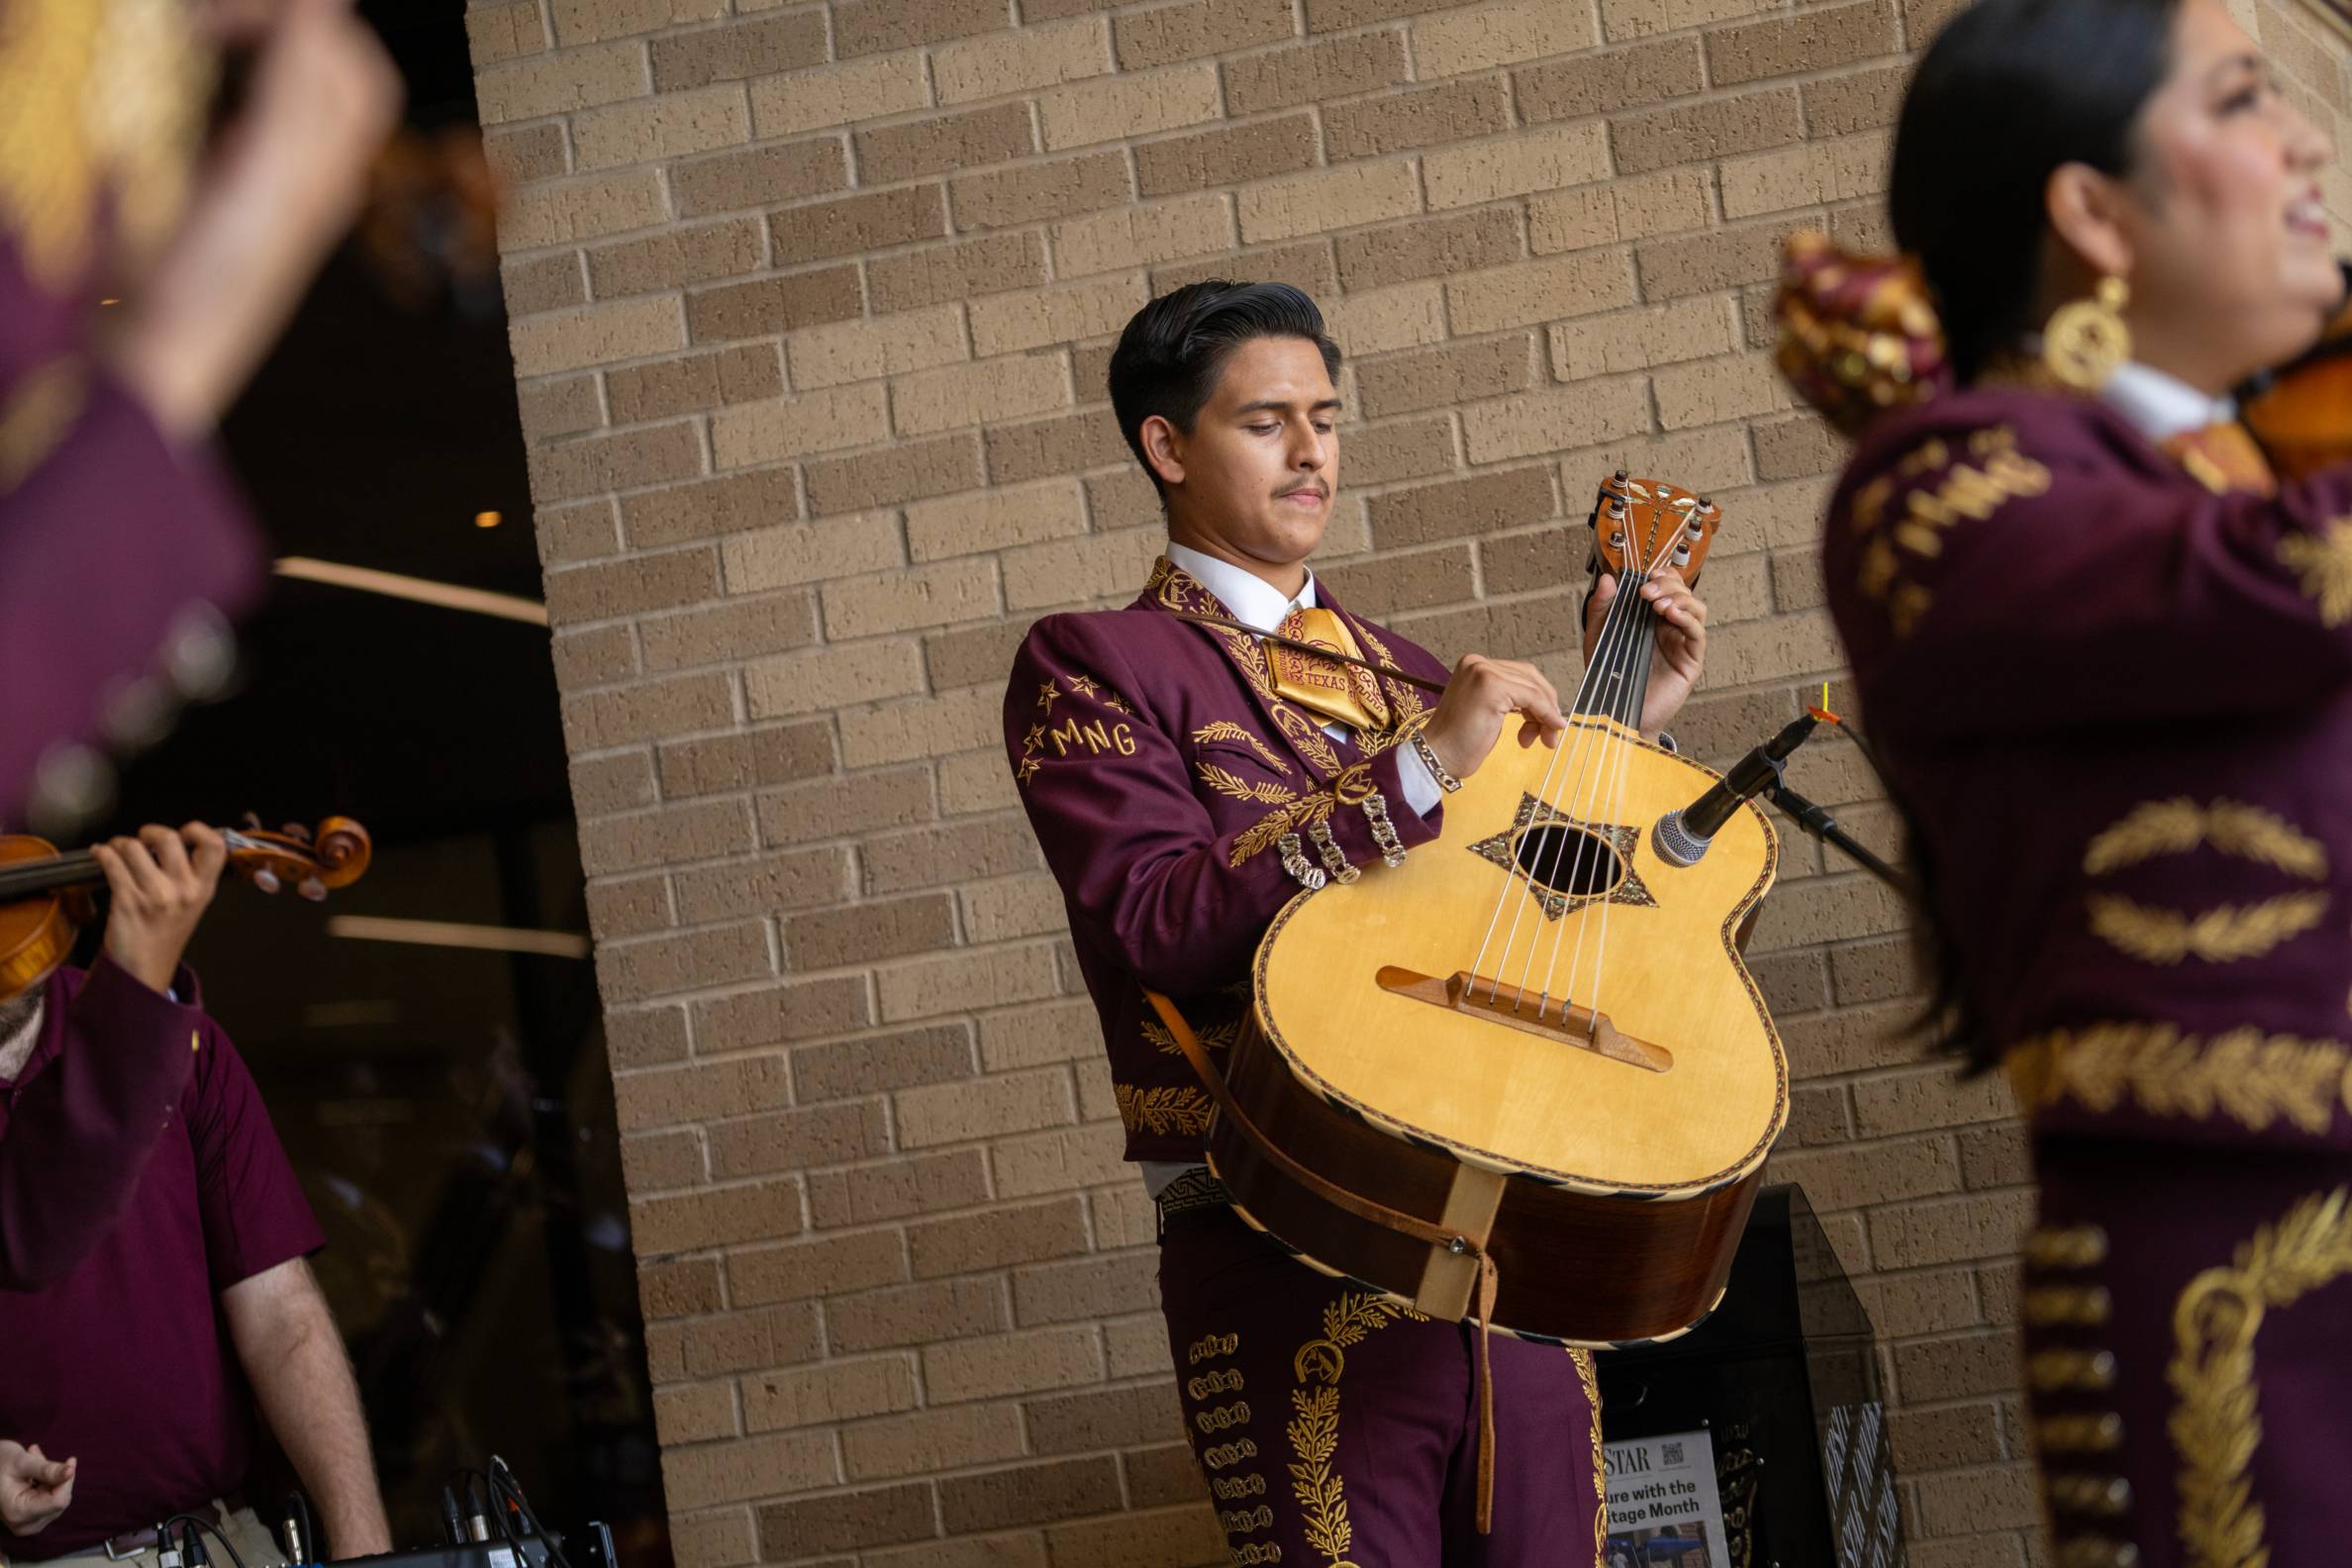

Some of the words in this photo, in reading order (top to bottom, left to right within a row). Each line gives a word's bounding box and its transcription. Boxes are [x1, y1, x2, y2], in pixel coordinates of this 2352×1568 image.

[1306, 673, 1345, 691] TEXAS
[1050, 718, 1136, 756] MNG
[1604, 1447, 1651, 1476] STAR
[1631, 1483, 1667, 1501] with
[1669, 1479, 1696, 1496] the
[1648, 1498, 1701, 1519] Month
